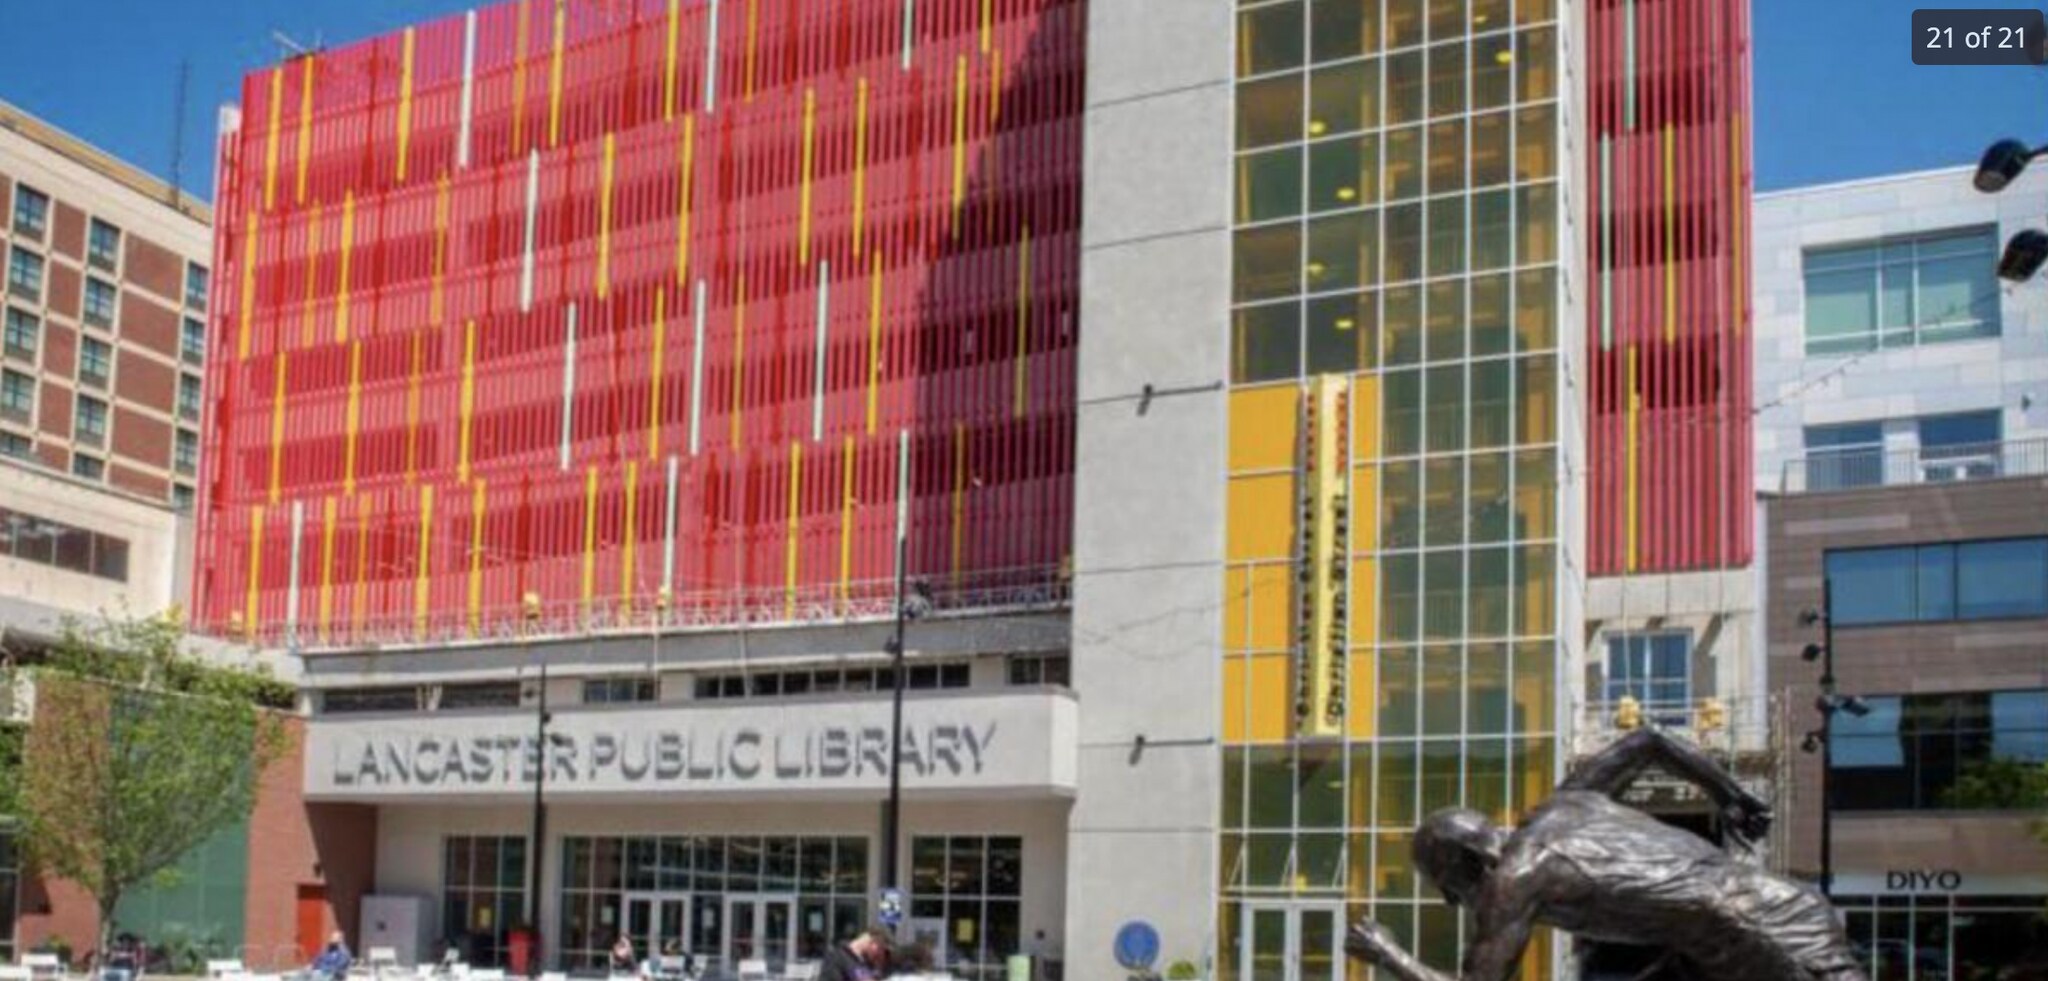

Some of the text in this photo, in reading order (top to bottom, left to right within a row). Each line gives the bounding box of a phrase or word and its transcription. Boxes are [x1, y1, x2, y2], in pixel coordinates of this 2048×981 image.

[333, 721, 998, 785] LANCASTER PUBLIC LIBRARY
[1886, 870, 1962, 891] DIYO
